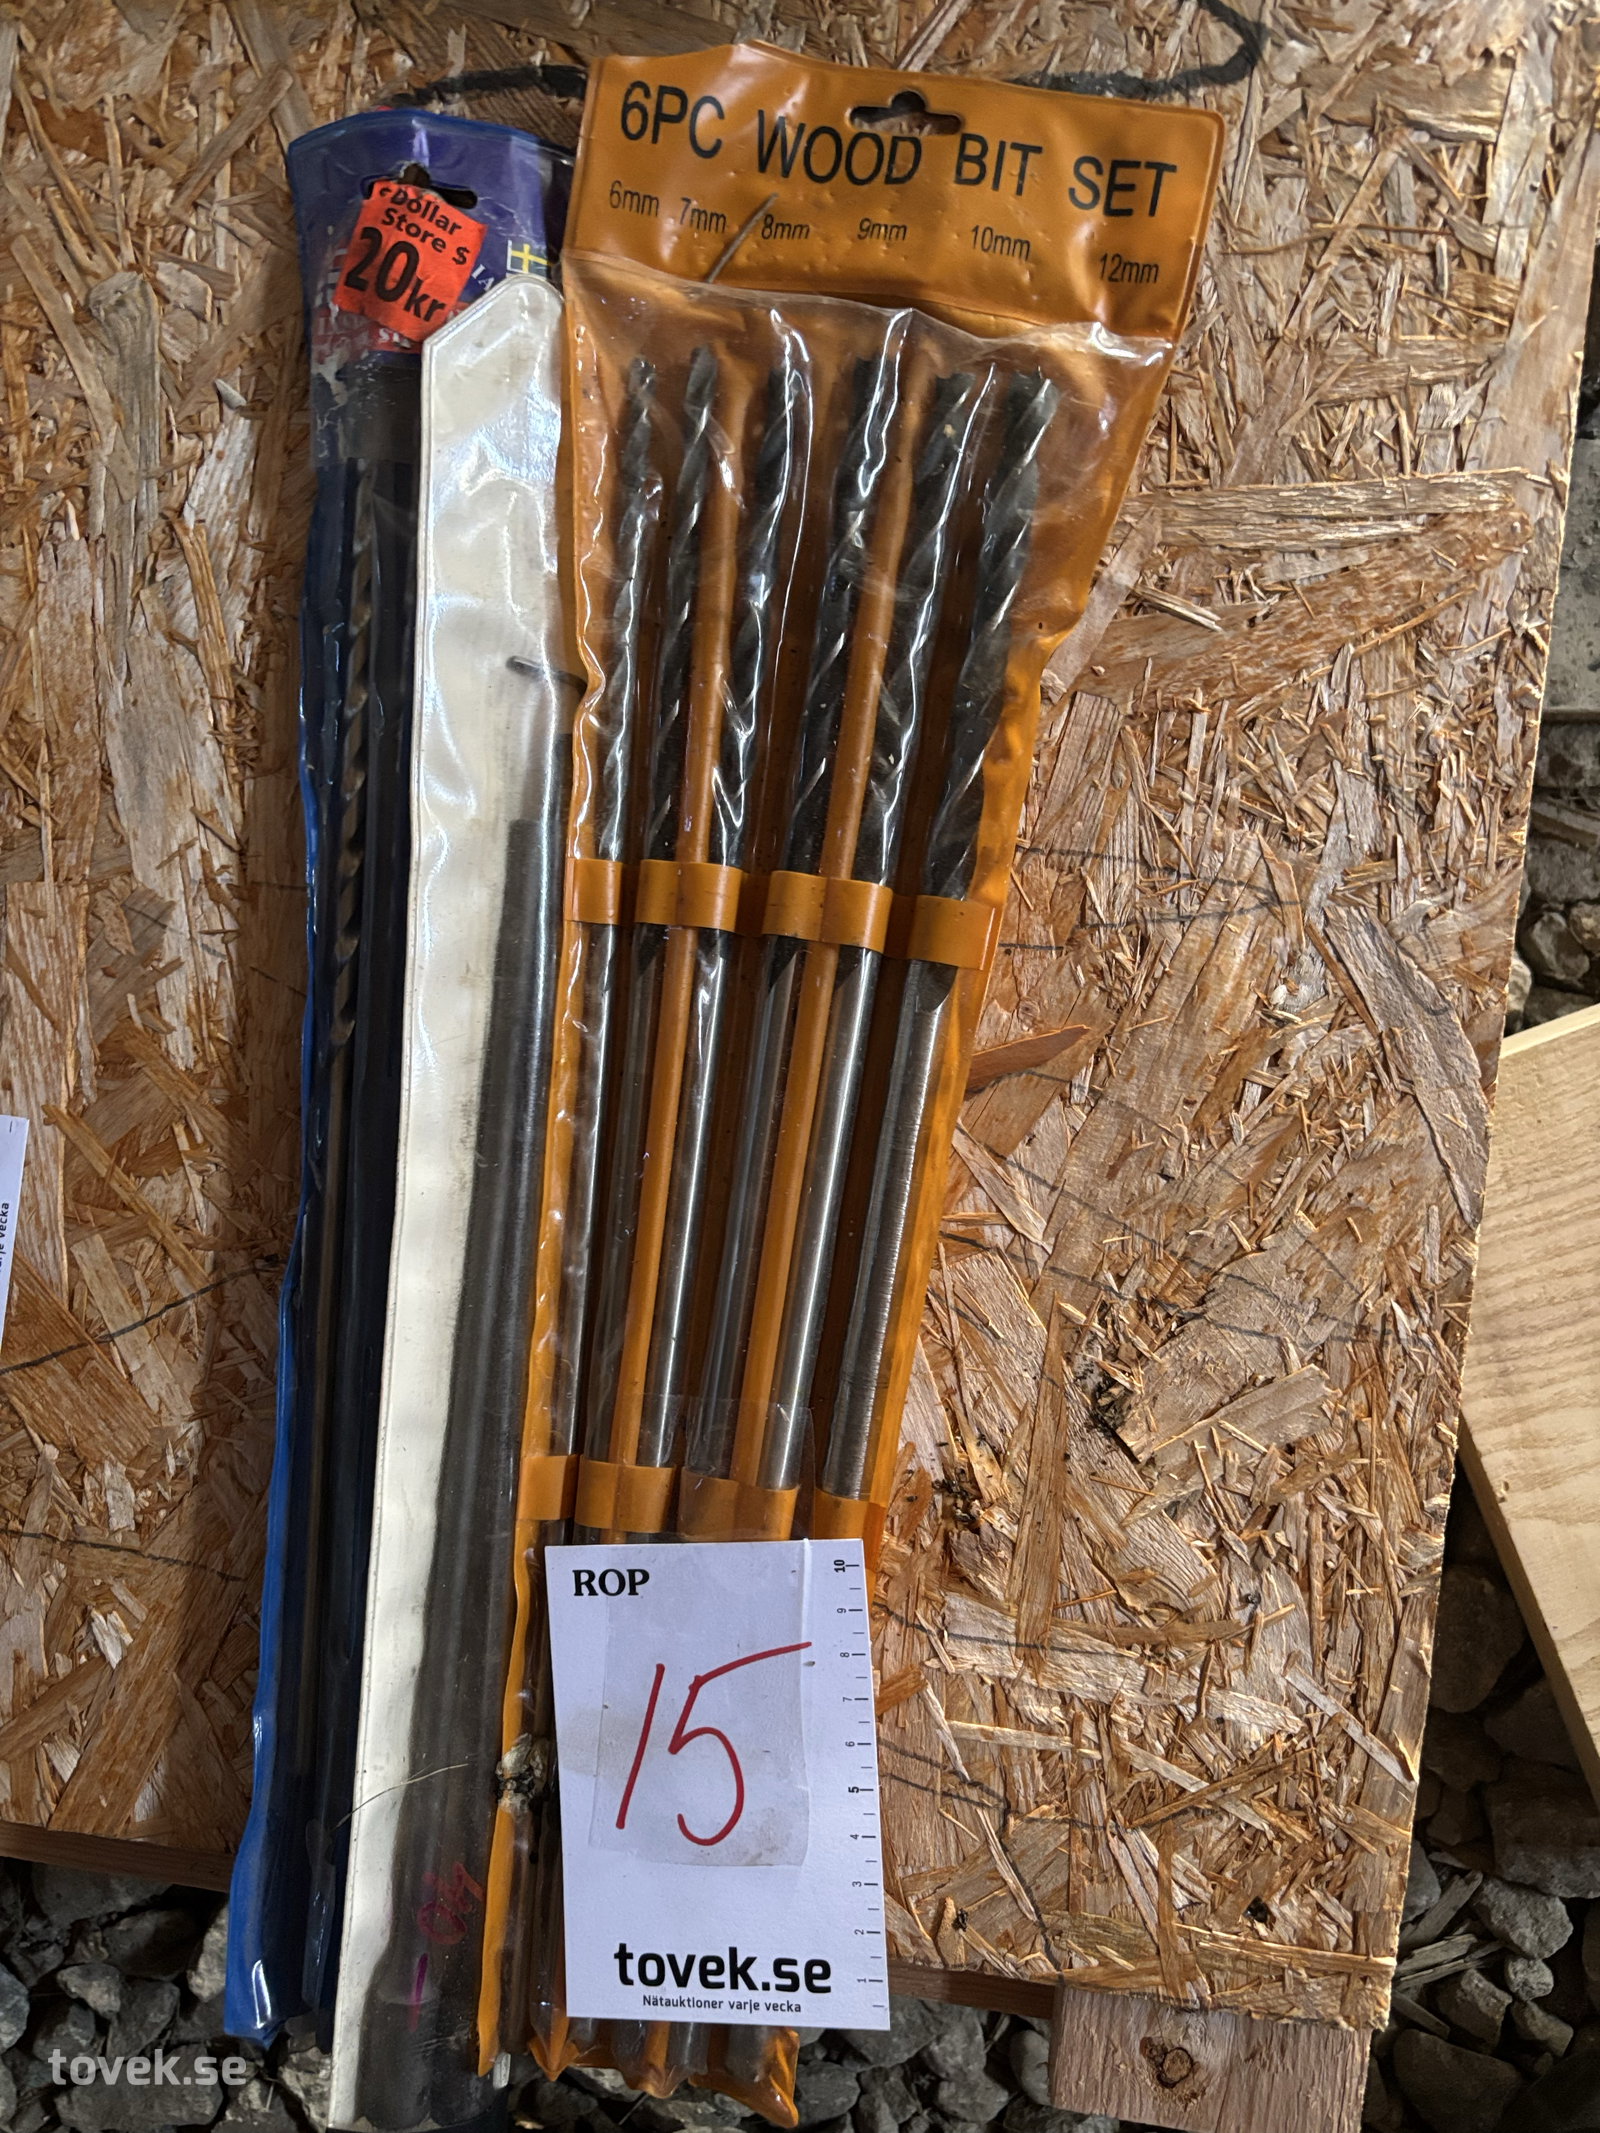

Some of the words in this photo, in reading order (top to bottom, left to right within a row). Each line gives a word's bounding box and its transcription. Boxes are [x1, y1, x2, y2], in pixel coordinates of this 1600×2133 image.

[620, 80, 725, 159] 6PC
[756, 109, 922, 186] WOOD
[953, 132, 1043, 197] BIT
[1068, 156, 1177, 218] SET
[390, 187, 463, 235] Dollar
[381, 207, 447, 254] Store
[608, 179, 660, 217] 6mm
[679, 196, 727, 234] 7mm
[761, 213, 810, 240] 8mm
[856, 217, 908, 241] 9mm
[970, 224, 1031, 262] 10mm
[1100, 252, 1160, 284] 12mm
[343, 226, 447, 322] 20kr
[572, 1568, 650, 1597] ROP
[833, 1559, 846, 1573] 10
[615, 1641, 812, 1847] 15
[845, 1740, 856, 1748] 6
[848, 1785, 860, 1794] 5
[851, 1880, 863, 1888] 3
[854, 1928, 865, 1936] 2
[613, 1942, 832, 1994] tovek.se
[642, 1994, 724, 2010] Nätauktioner
[728, 1999, 760, 2014] varje
[764, 2000, 802, 2013] vecka
